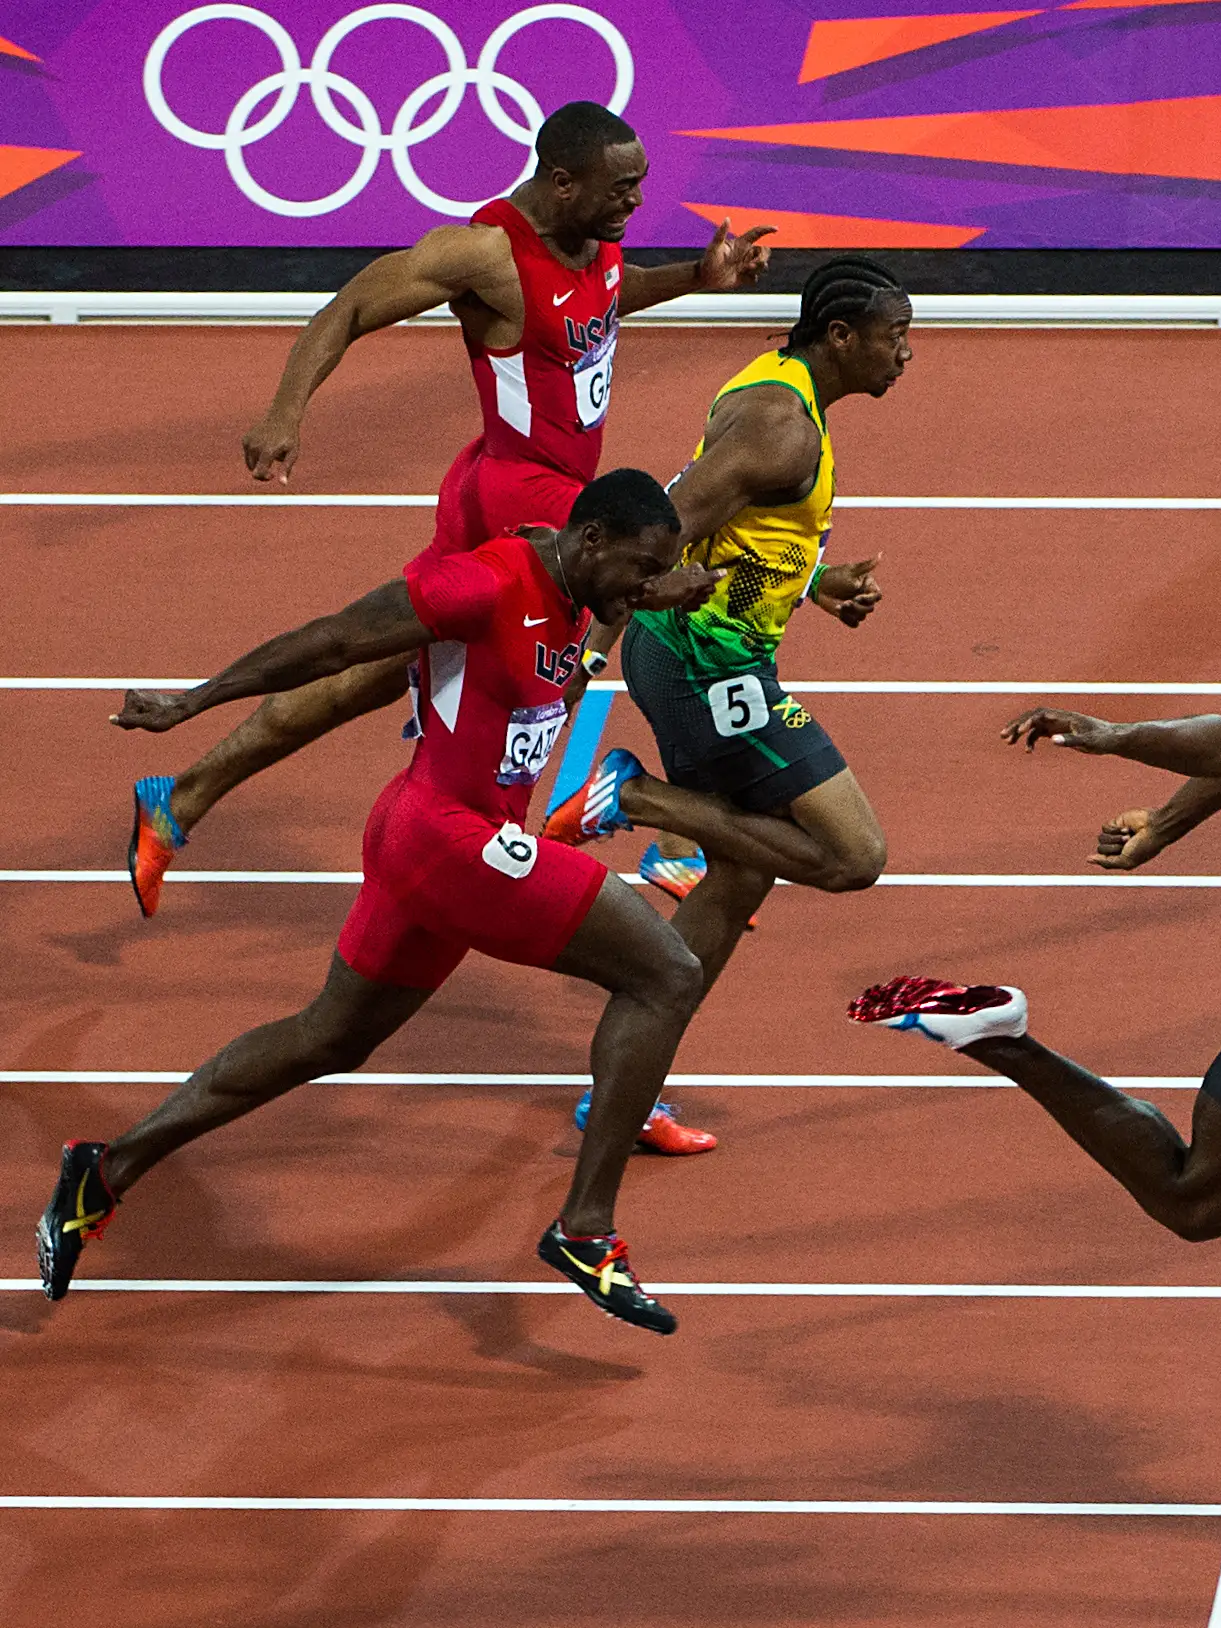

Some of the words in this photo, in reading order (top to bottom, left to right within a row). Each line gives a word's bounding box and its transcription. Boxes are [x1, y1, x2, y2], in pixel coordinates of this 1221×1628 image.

[535, 613, 593, 688] US
[726, 684, 751, 729] 5
[497, 834, 532, 863] 6
